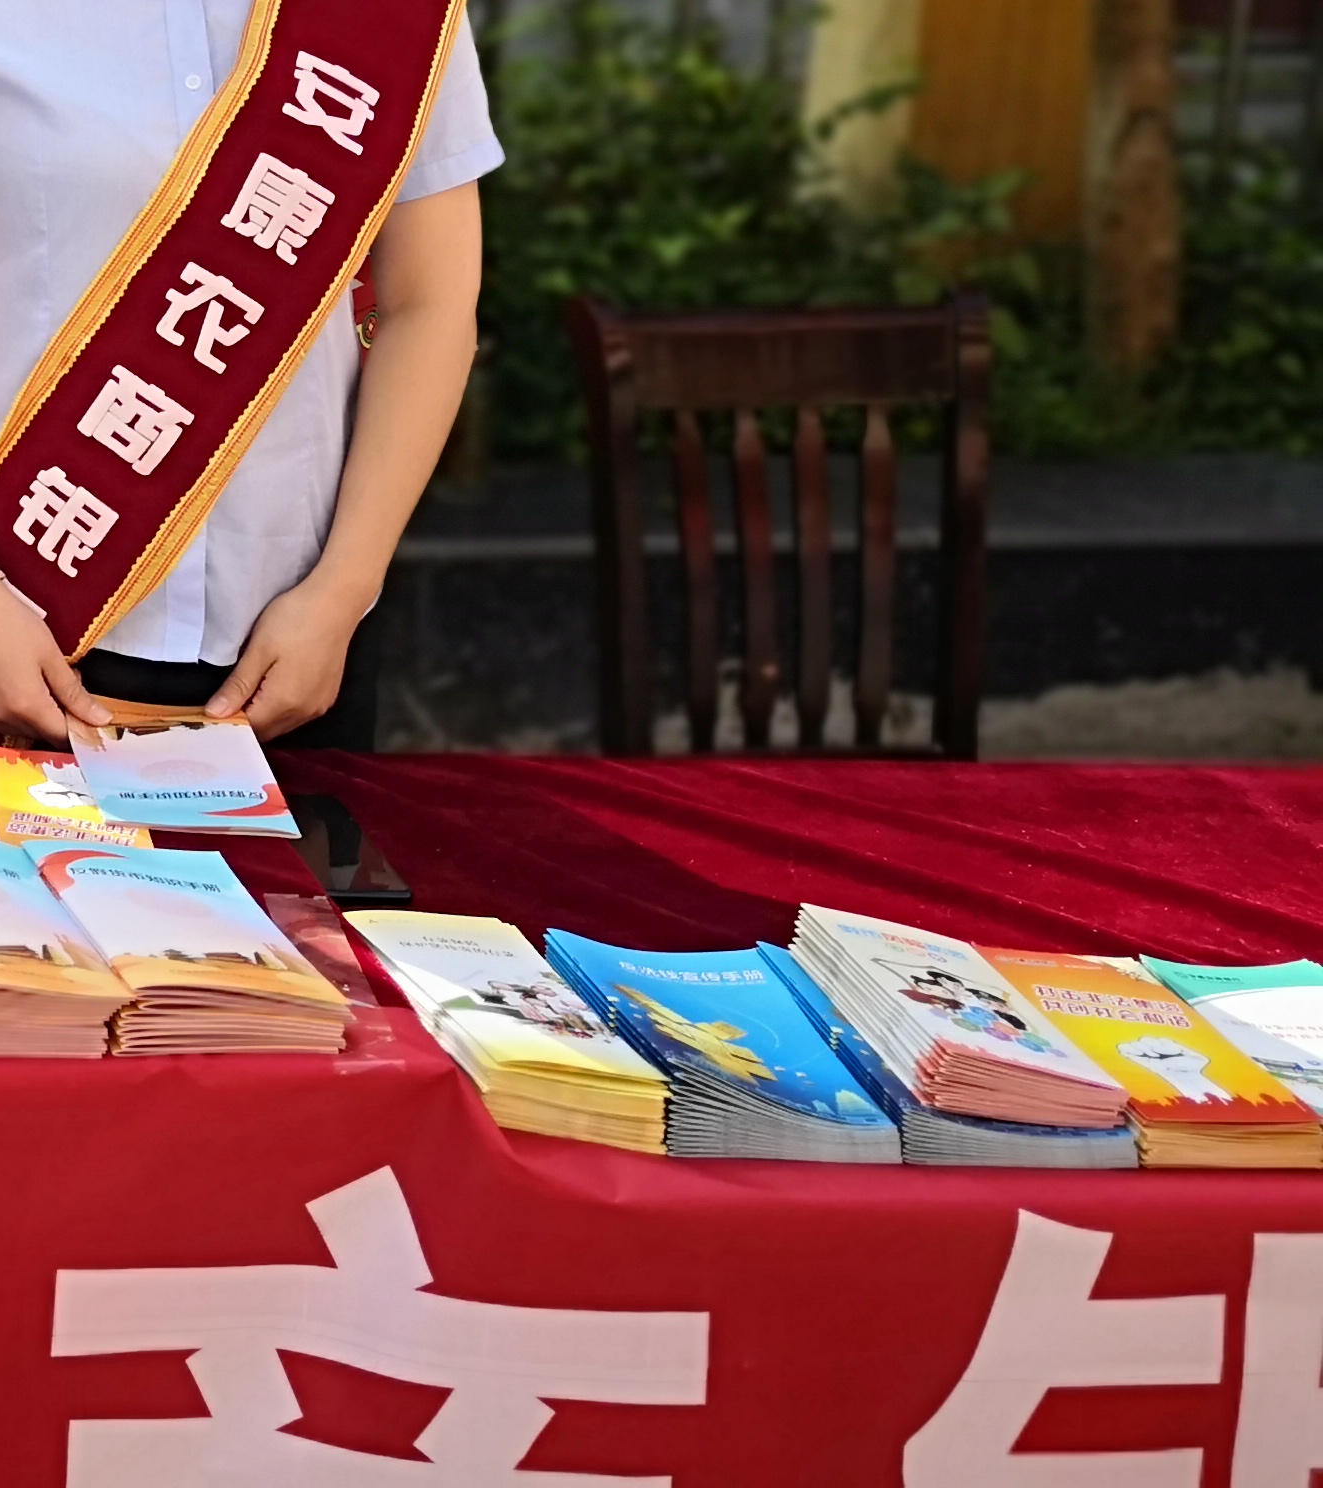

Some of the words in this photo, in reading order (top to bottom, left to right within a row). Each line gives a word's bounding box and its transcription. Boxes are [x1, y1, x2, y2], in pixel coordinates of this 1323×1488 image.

[68, 864, 221, 894] 反假货币知识手册
[1032, 983, 1184, 1014] 打击非法集资
[1040, 997, 1193, 1028] 共创社会和谐
